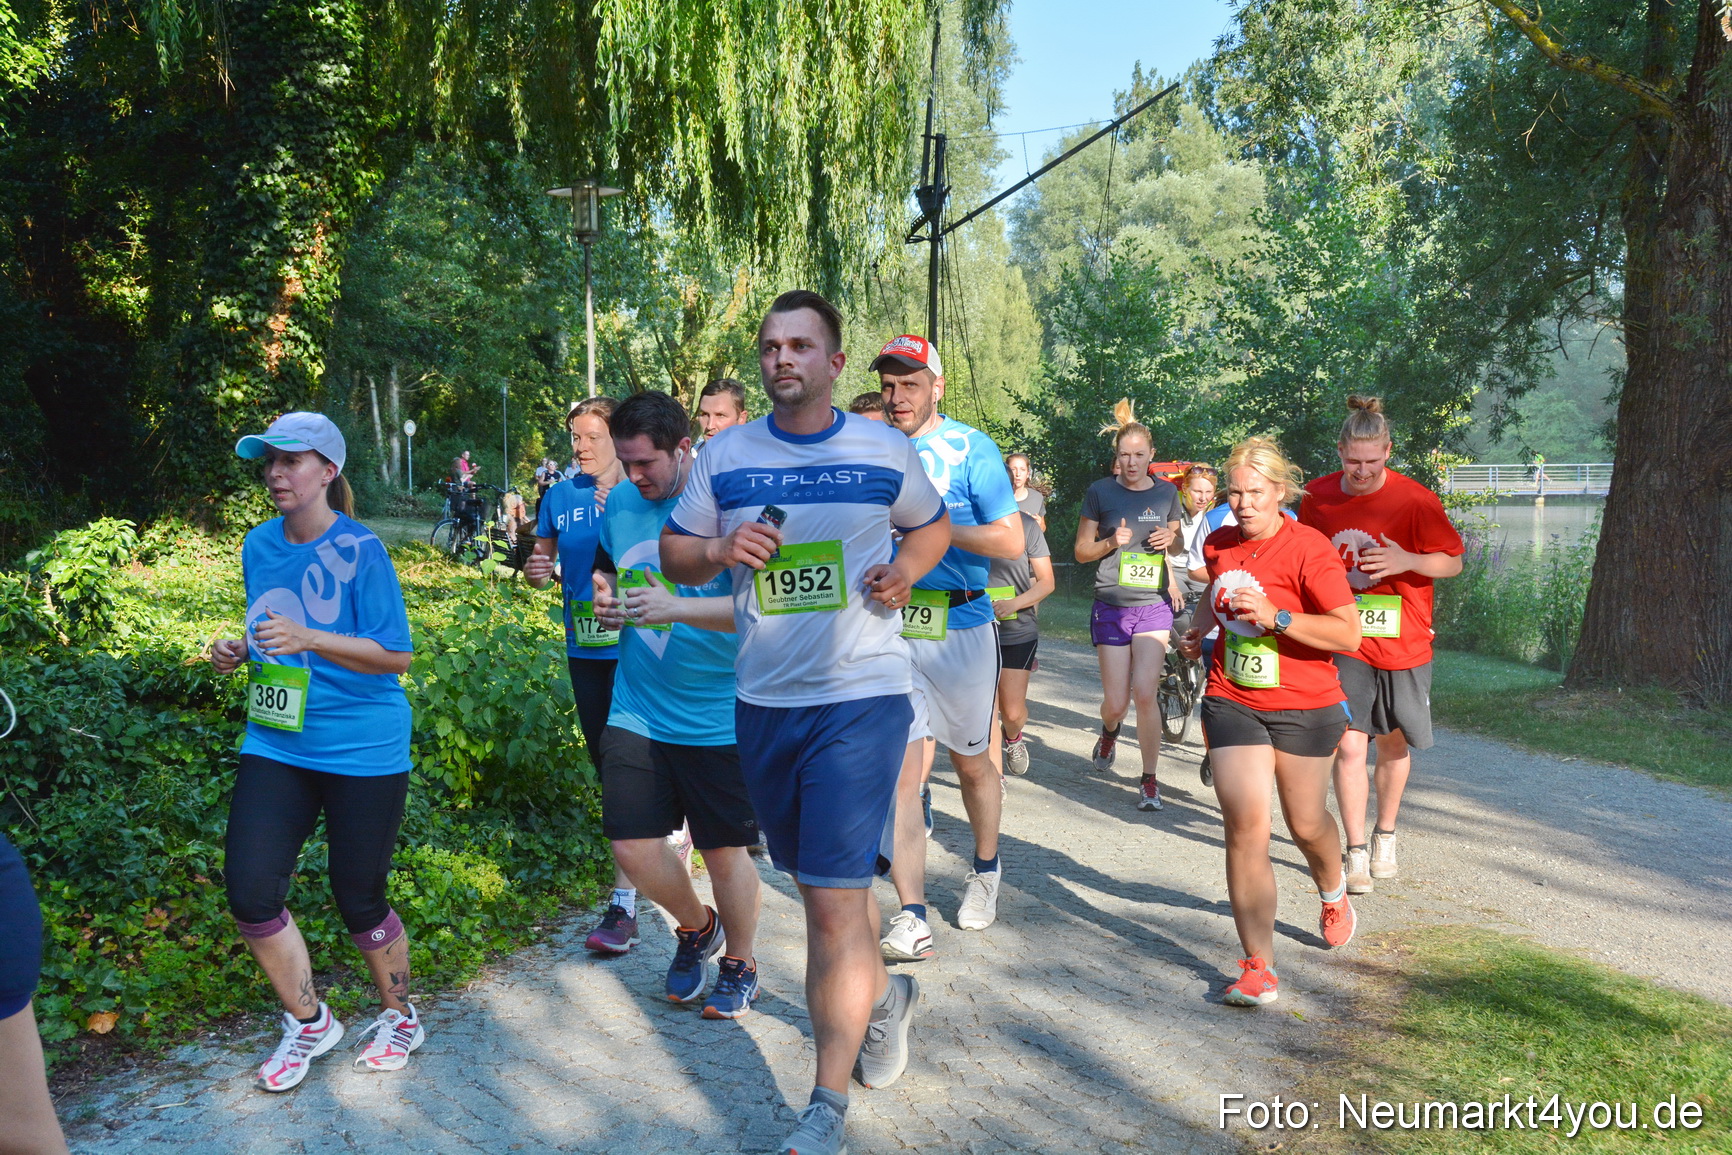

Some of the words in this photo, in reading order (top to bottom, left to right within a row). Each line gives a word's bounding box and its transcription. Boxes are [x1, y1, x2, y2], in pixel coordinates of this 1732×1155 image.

[747, 474, 773, 488] TR
[782, 471, 867, 485] PLAST
[1130, 565, 1154, 578] 324
[765, 566, 833, 596] 1952
[768, 595, 797, 604] Geubtner
[799, 592, 834, 601] Sebastian
[1231, 651, 1262, 673] 773
[255, 684, 288, 711] 380
[272, 710, 296, 720] Franziska
